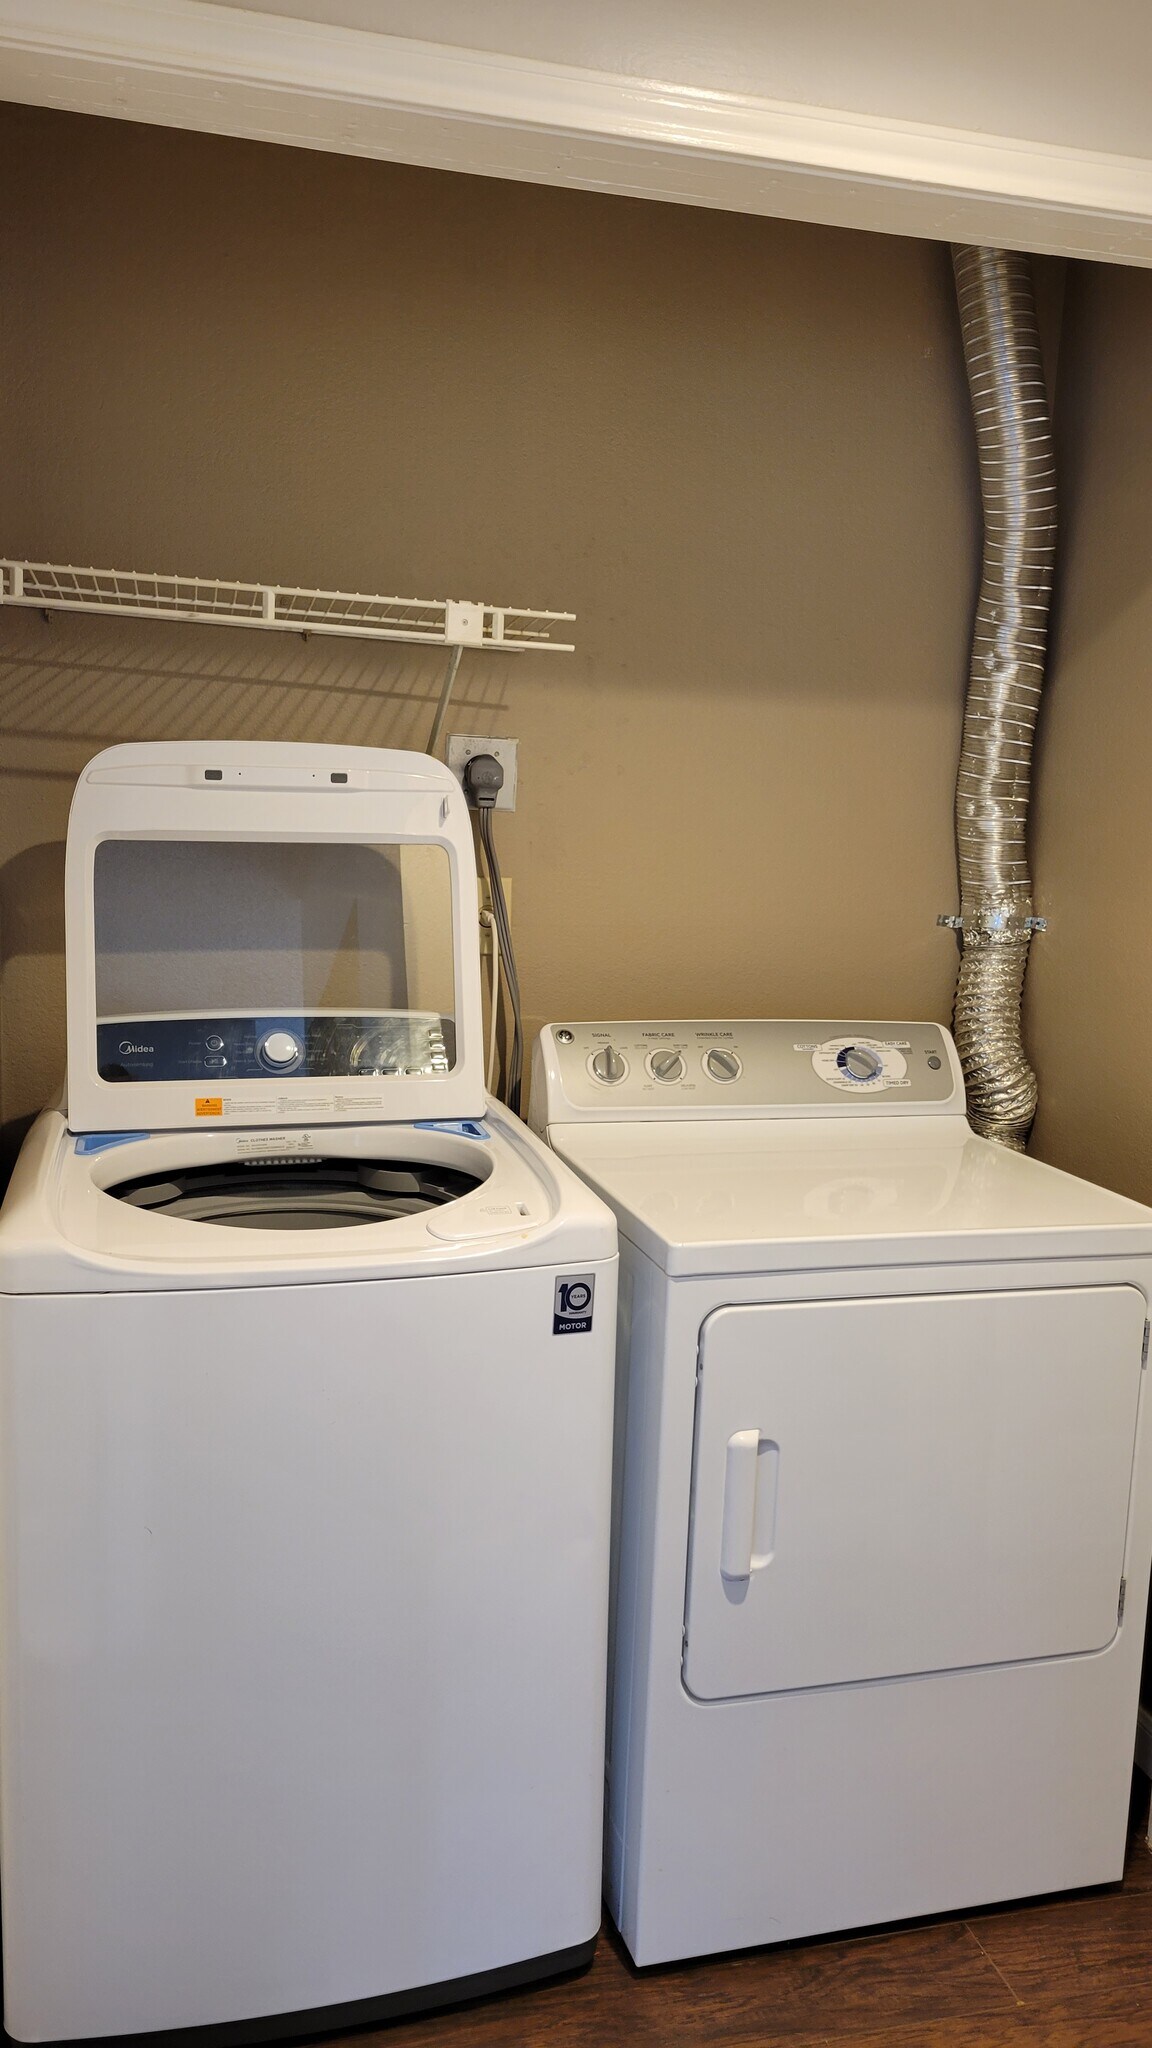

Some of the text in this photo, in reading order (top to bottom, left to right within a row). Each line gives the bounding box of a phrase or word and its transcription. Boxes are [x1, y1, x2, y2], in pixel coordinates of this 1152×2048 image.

[119, 1041, 155, 1054] Midea
[558, 1282, 592, 1312] 10
[559, 1321, 587, 1331] MOTOR
